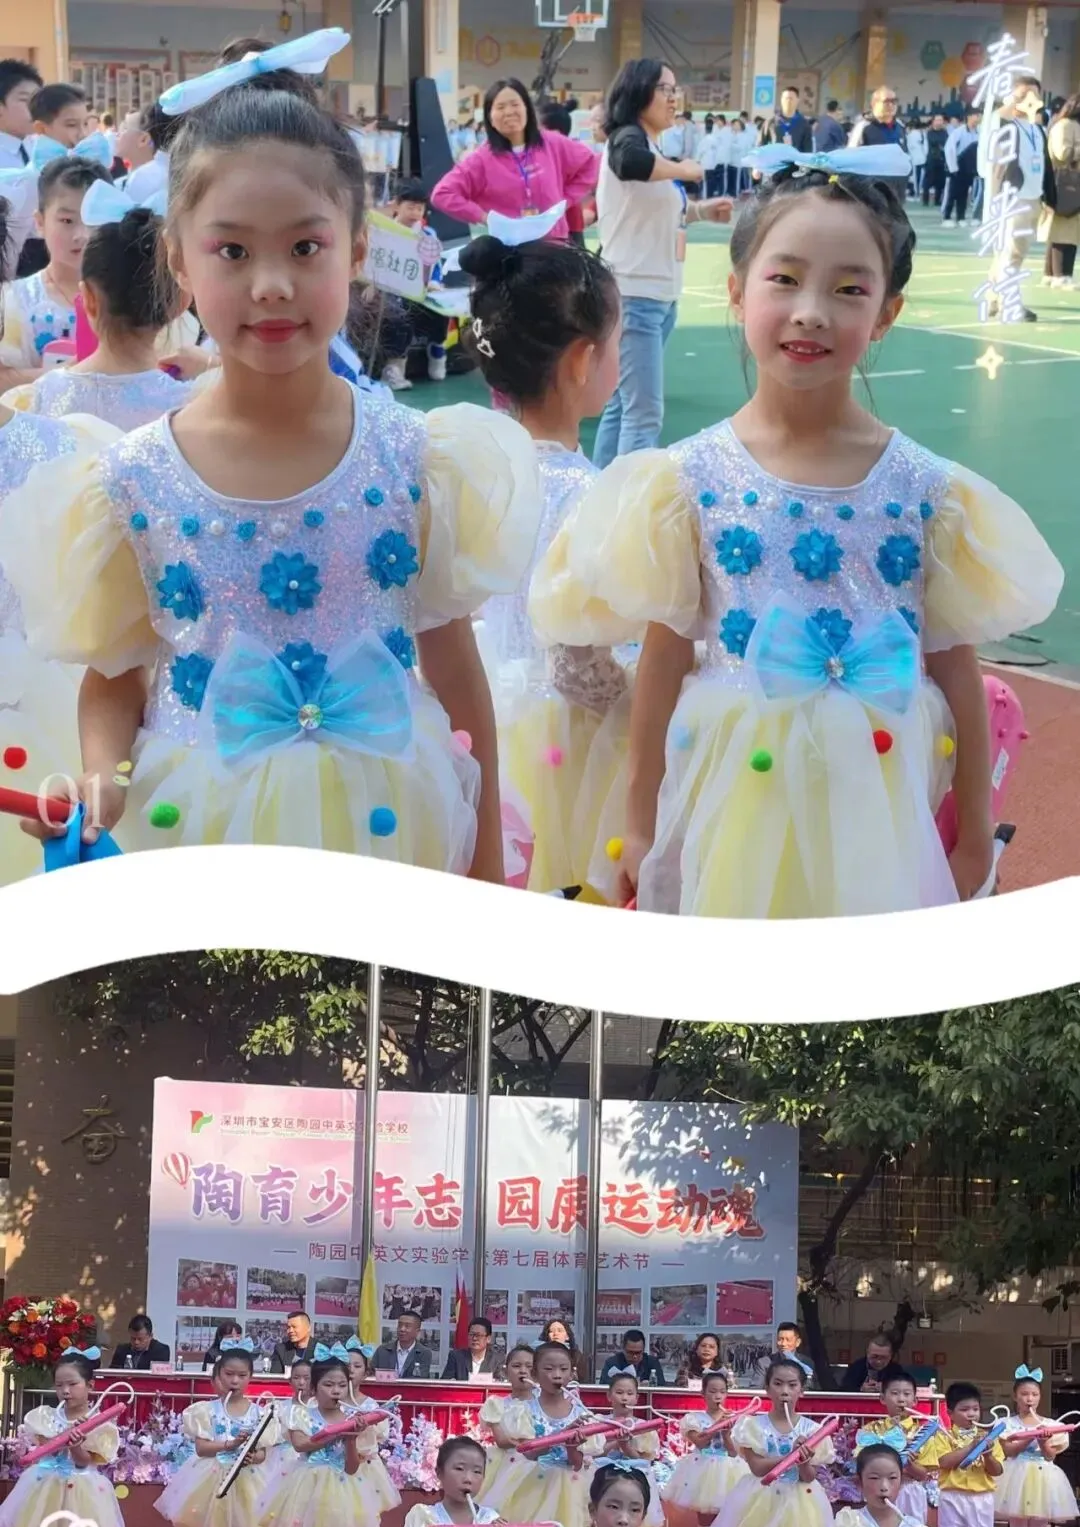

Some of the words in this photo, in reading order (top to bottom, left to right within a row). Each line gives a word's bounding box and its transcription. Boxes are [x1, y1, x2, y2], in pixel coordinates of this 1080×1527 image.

[190, 1164, 463, 1228] 陶育少年志
[309, 1243, 650, 1270] 陶园中英文实验学第七届体育艺术节
